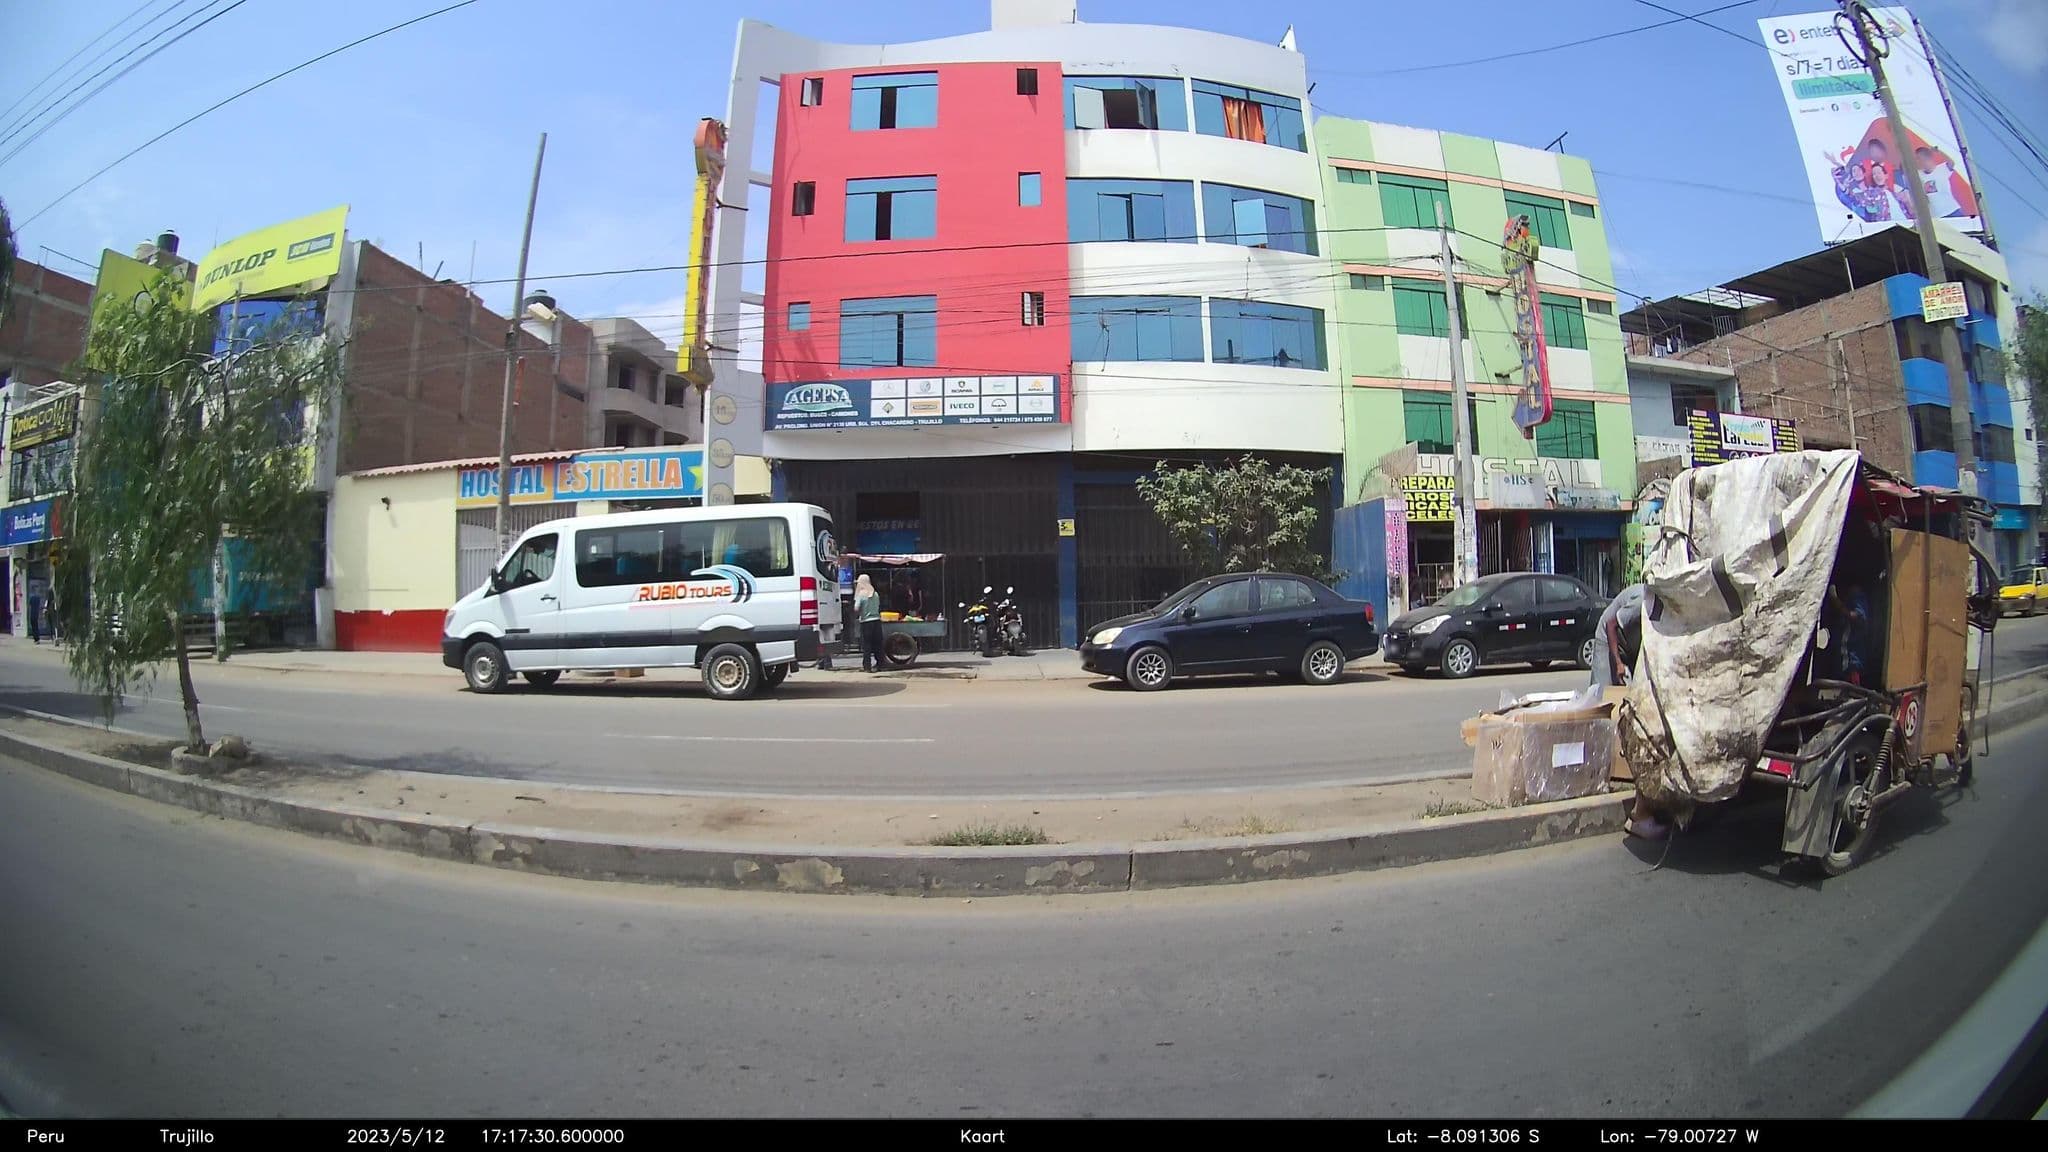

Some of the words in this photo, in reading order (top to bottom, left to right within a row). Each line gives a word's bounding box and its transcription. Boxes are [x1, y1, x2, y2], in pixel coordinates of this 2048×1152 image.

[202, 249, 277, 289] DUNLOP
[788, 388, 850, 404] AGEPSA
[557, 457, 684, 493] ESTRELLA
[639, 583, 687, 601] RUBIO
[689, 585, 732, 598] TOURS
